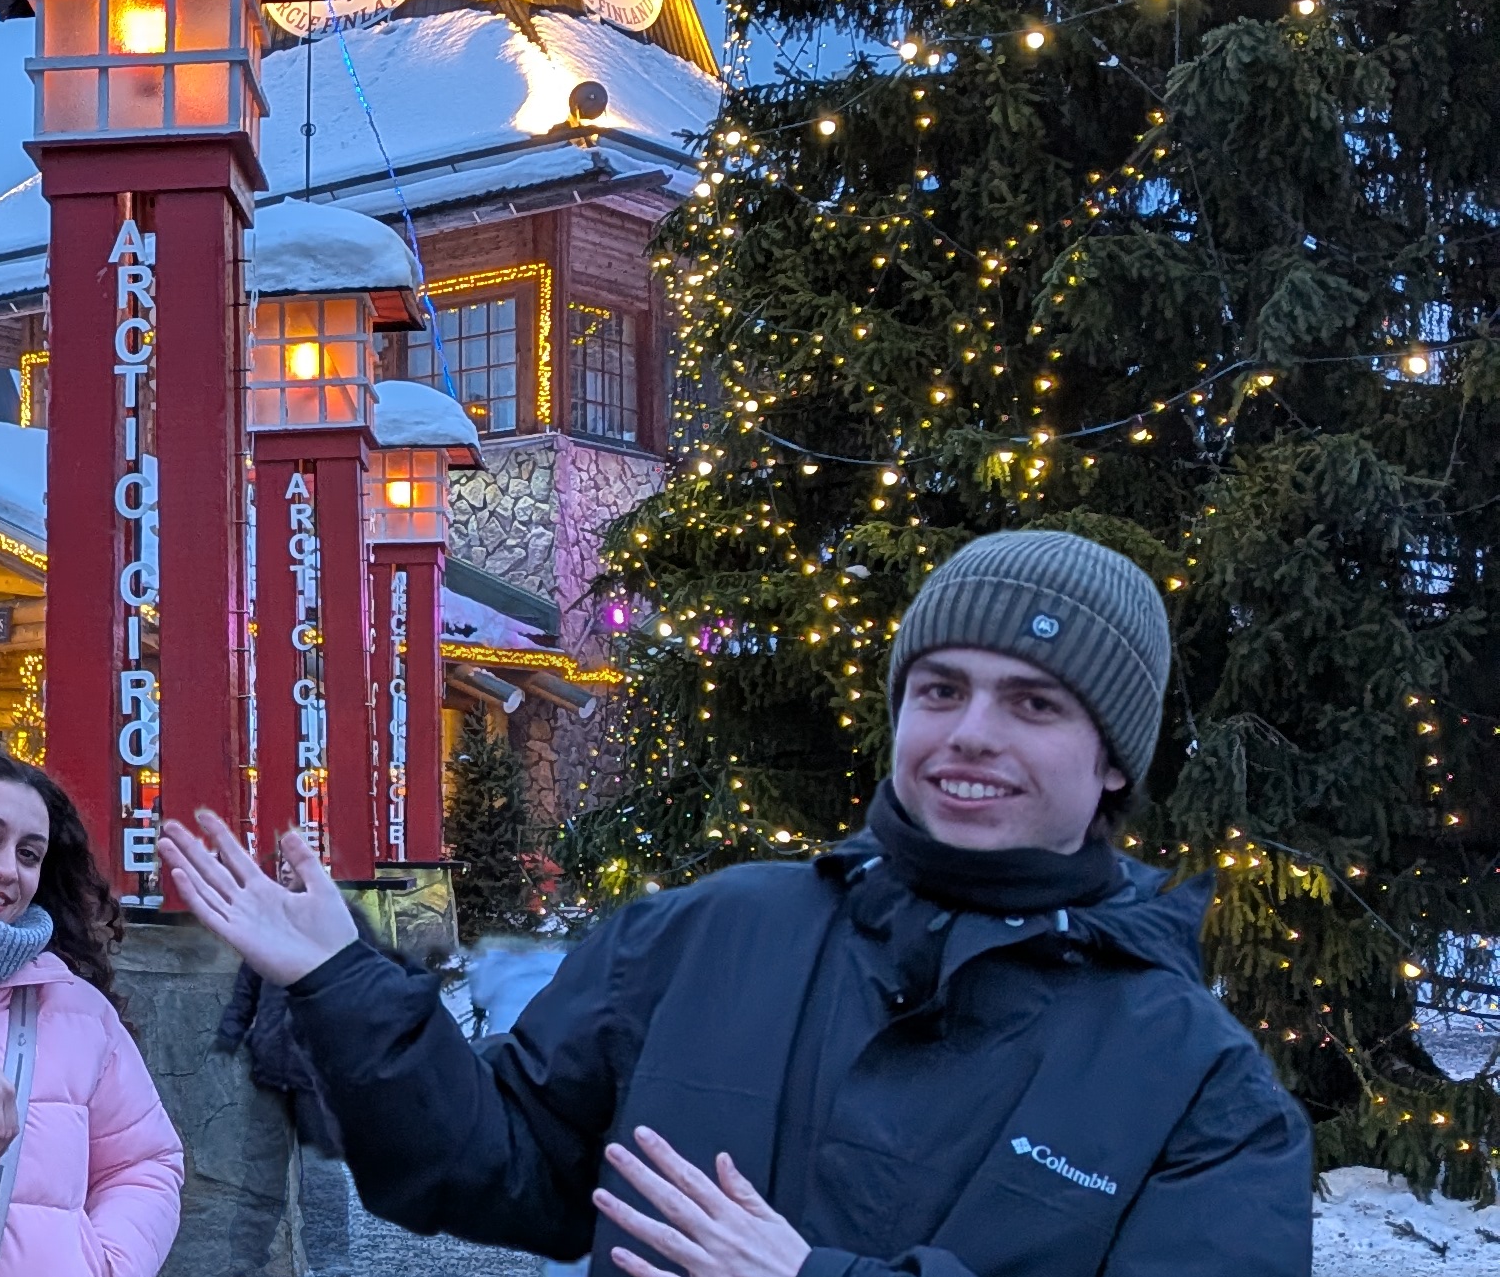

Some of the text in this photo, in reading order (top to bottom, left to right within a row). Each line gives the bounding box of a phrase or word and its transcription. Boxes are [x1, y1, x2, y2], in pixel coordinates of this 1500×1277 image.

[275, 2, 321, 34] RCLE
[108, 219, 159, 873] ARCTIC CIRCLE
[285, 472, 322, 857] ARCTIC CIRCLE
[1031, 1145, 1117, 1195] Columbia
